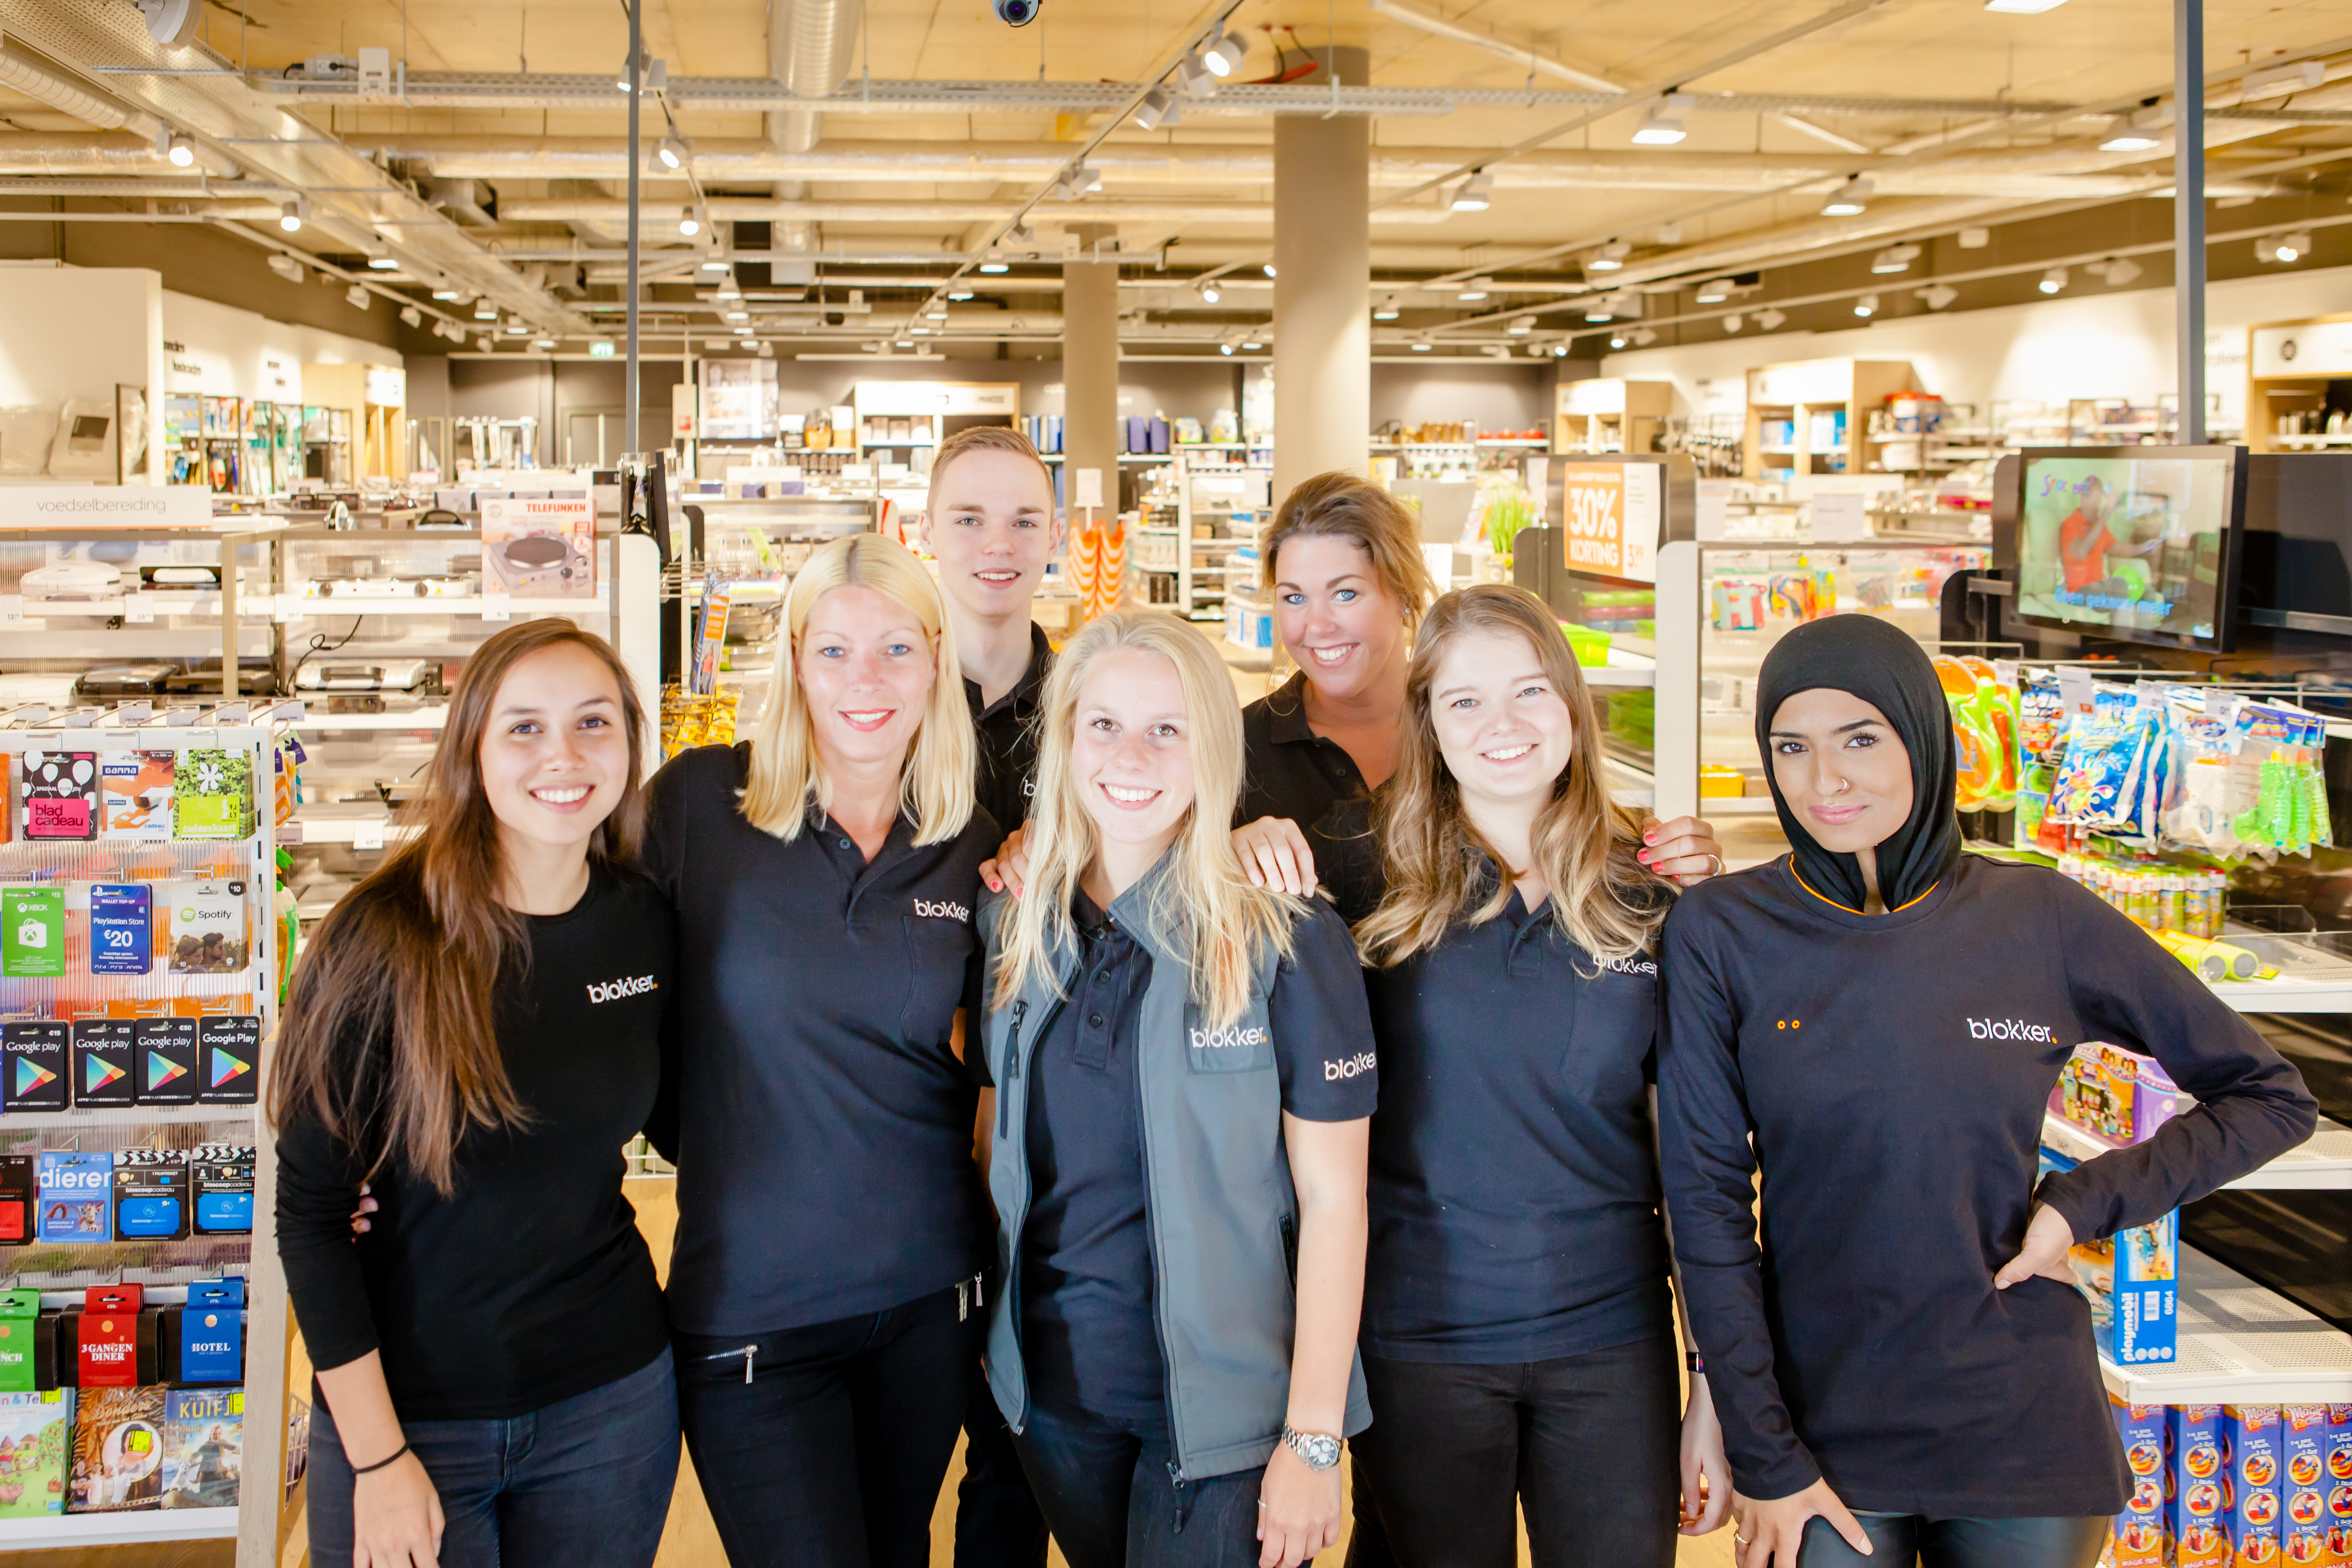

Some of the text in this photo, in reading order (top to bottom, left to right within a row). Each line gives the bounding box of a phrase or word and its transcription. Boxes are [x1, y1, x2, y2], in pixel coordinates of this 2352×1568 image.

[37, 498, 166, 514] voedselbereiding
[526, 504, 586, 512] TELEFUNKEN
[1569, 487, 1617, 539] 30%
[1570, 538, 1619, 567] KORTING
[35, 804, 63, 816] blad
[35, 815, 84, 826] cadeau
[183, 823, 237, 834] cadeaukaart
[198, 910, 231, 920] Spotify
[94, 917, 128, 926] PlayStation
[104, 929, 133, 947] €20
[1967, 1018, 2058, 1044] blokker.
[76, 1038, 130, 1051] Google play
[138, 1036, 191, 1048] Google play
[202, 1033, 256, 1045] Google Play
[6, 1041, 61, 1054] Google play
[2121, 1292, 2136, 1362] playmobil
[82, 1343, 133, 1353] 3 GANGEN
[191, 1342, 231, 1352] HOTEL
[91, 1352, 125, 1361] DINER
[13, 1393, 21, 1404] &
[179, 1400, 242, 1419] KUIFJ
[2241, 1405, 2279, 1423] Magic
[2287, 1404, 2325, 1422] Magic
